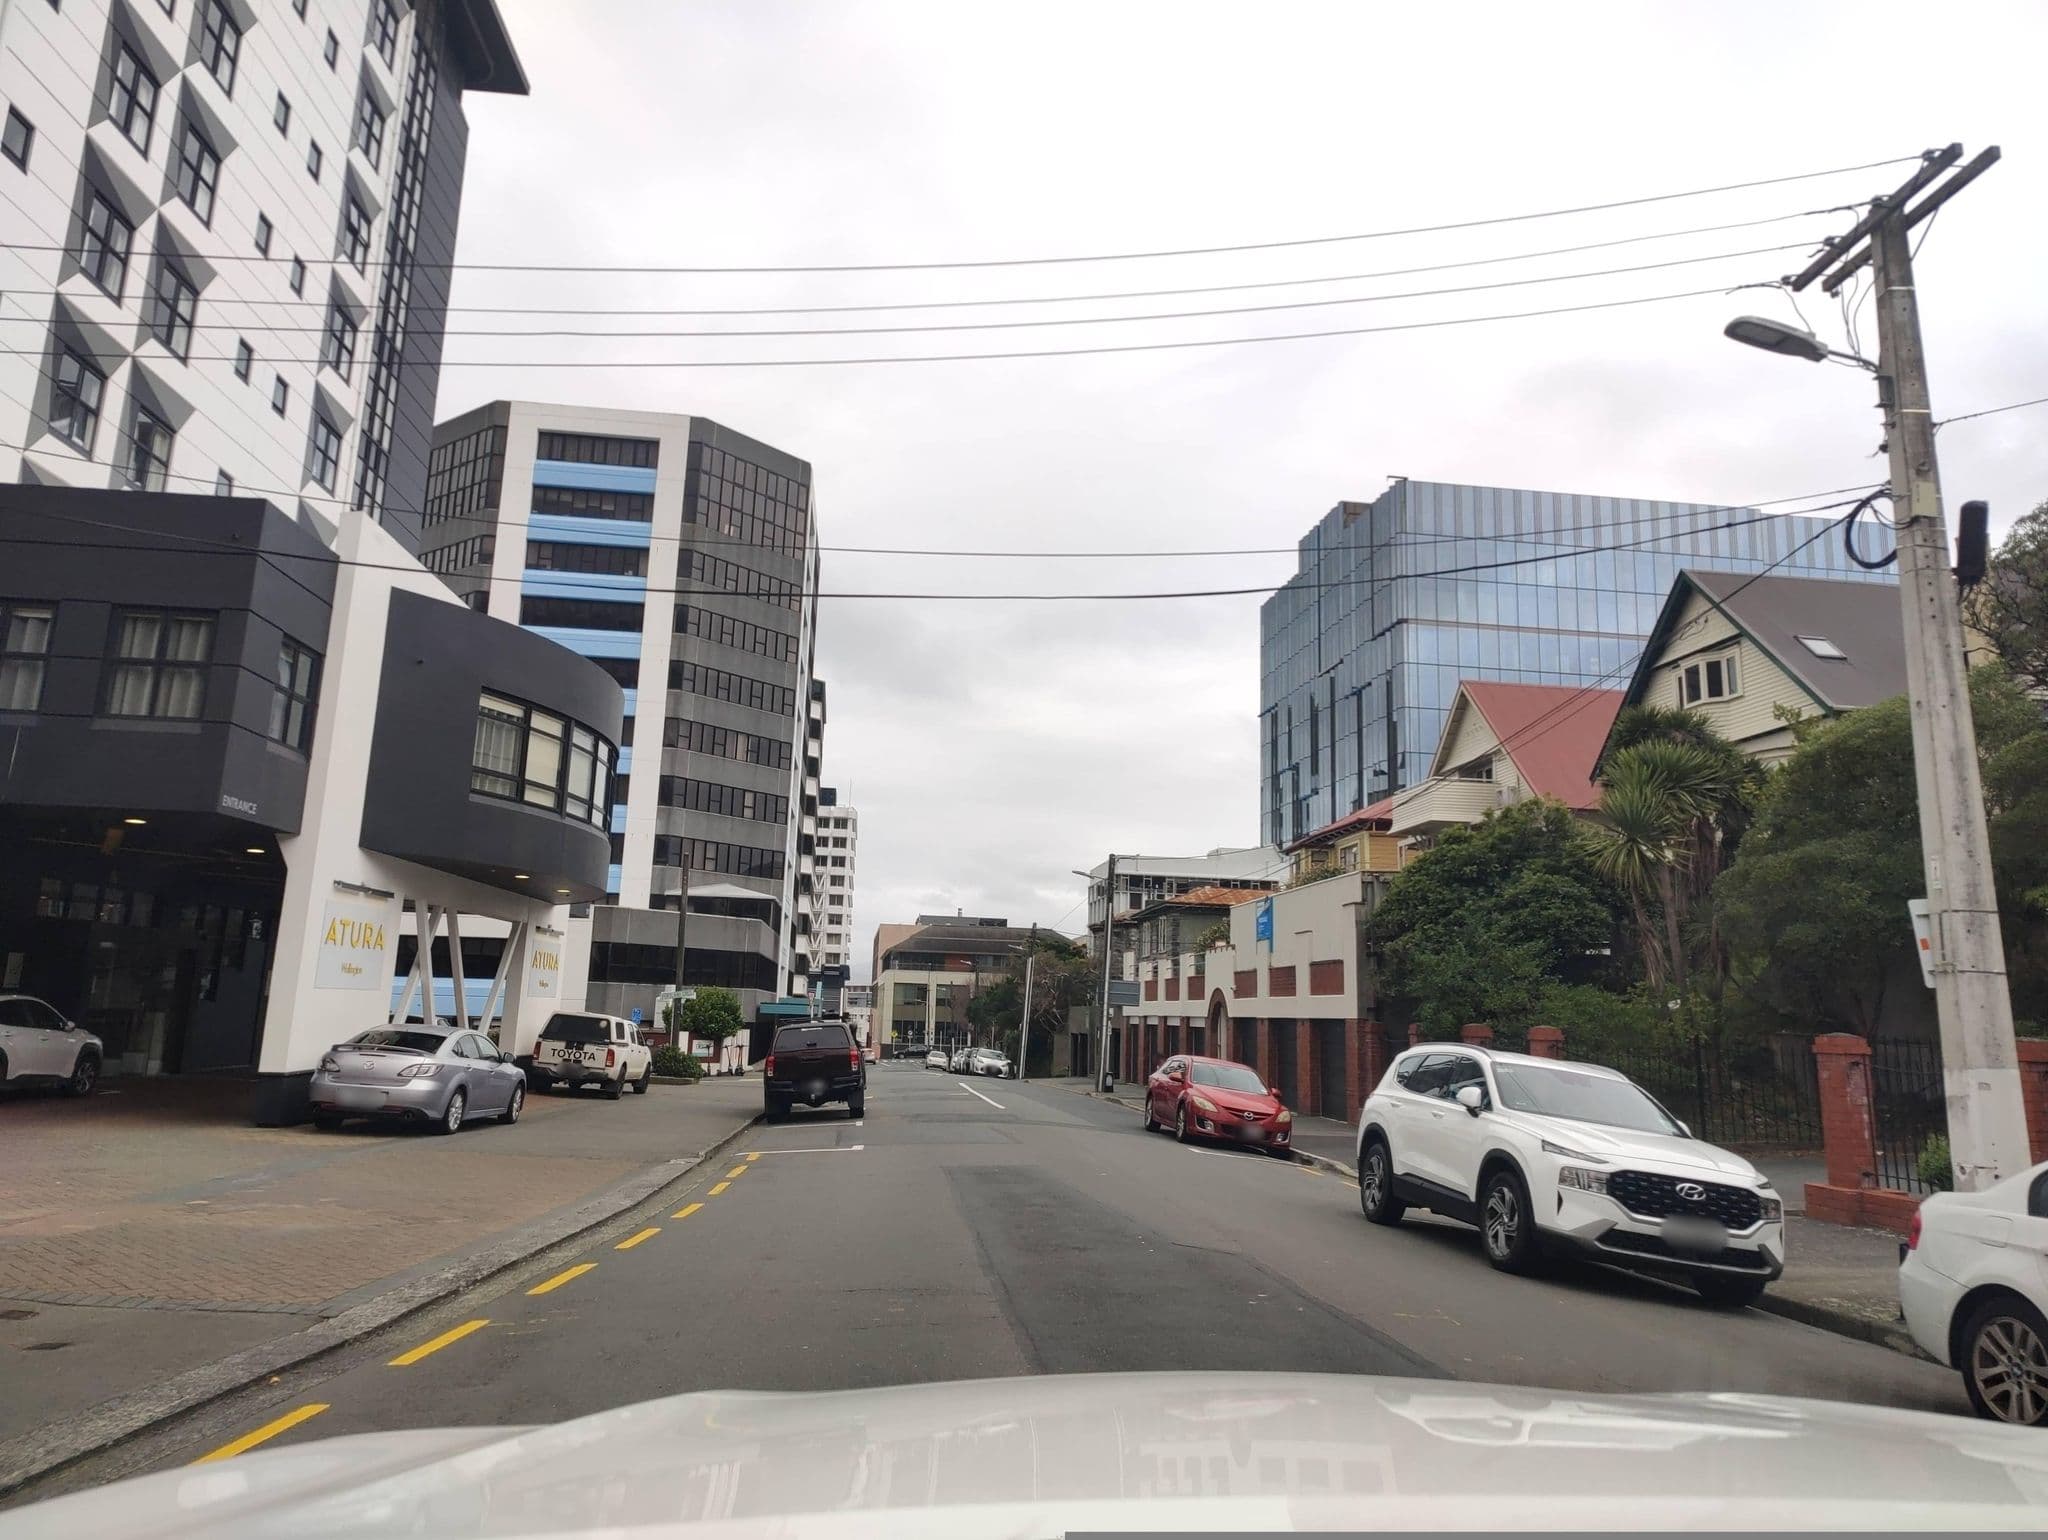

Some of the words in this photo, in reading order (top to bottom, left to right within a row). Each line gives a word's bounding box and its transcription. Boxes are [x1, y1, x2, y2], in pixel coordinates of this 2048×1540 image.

[222, 794, 258, 815] ENTRANCE
[324, 917, 384, 951] ATURA
[531, 950, 559, 971] ATURA
[551, 1048, 596, 1061] TOYOTA
